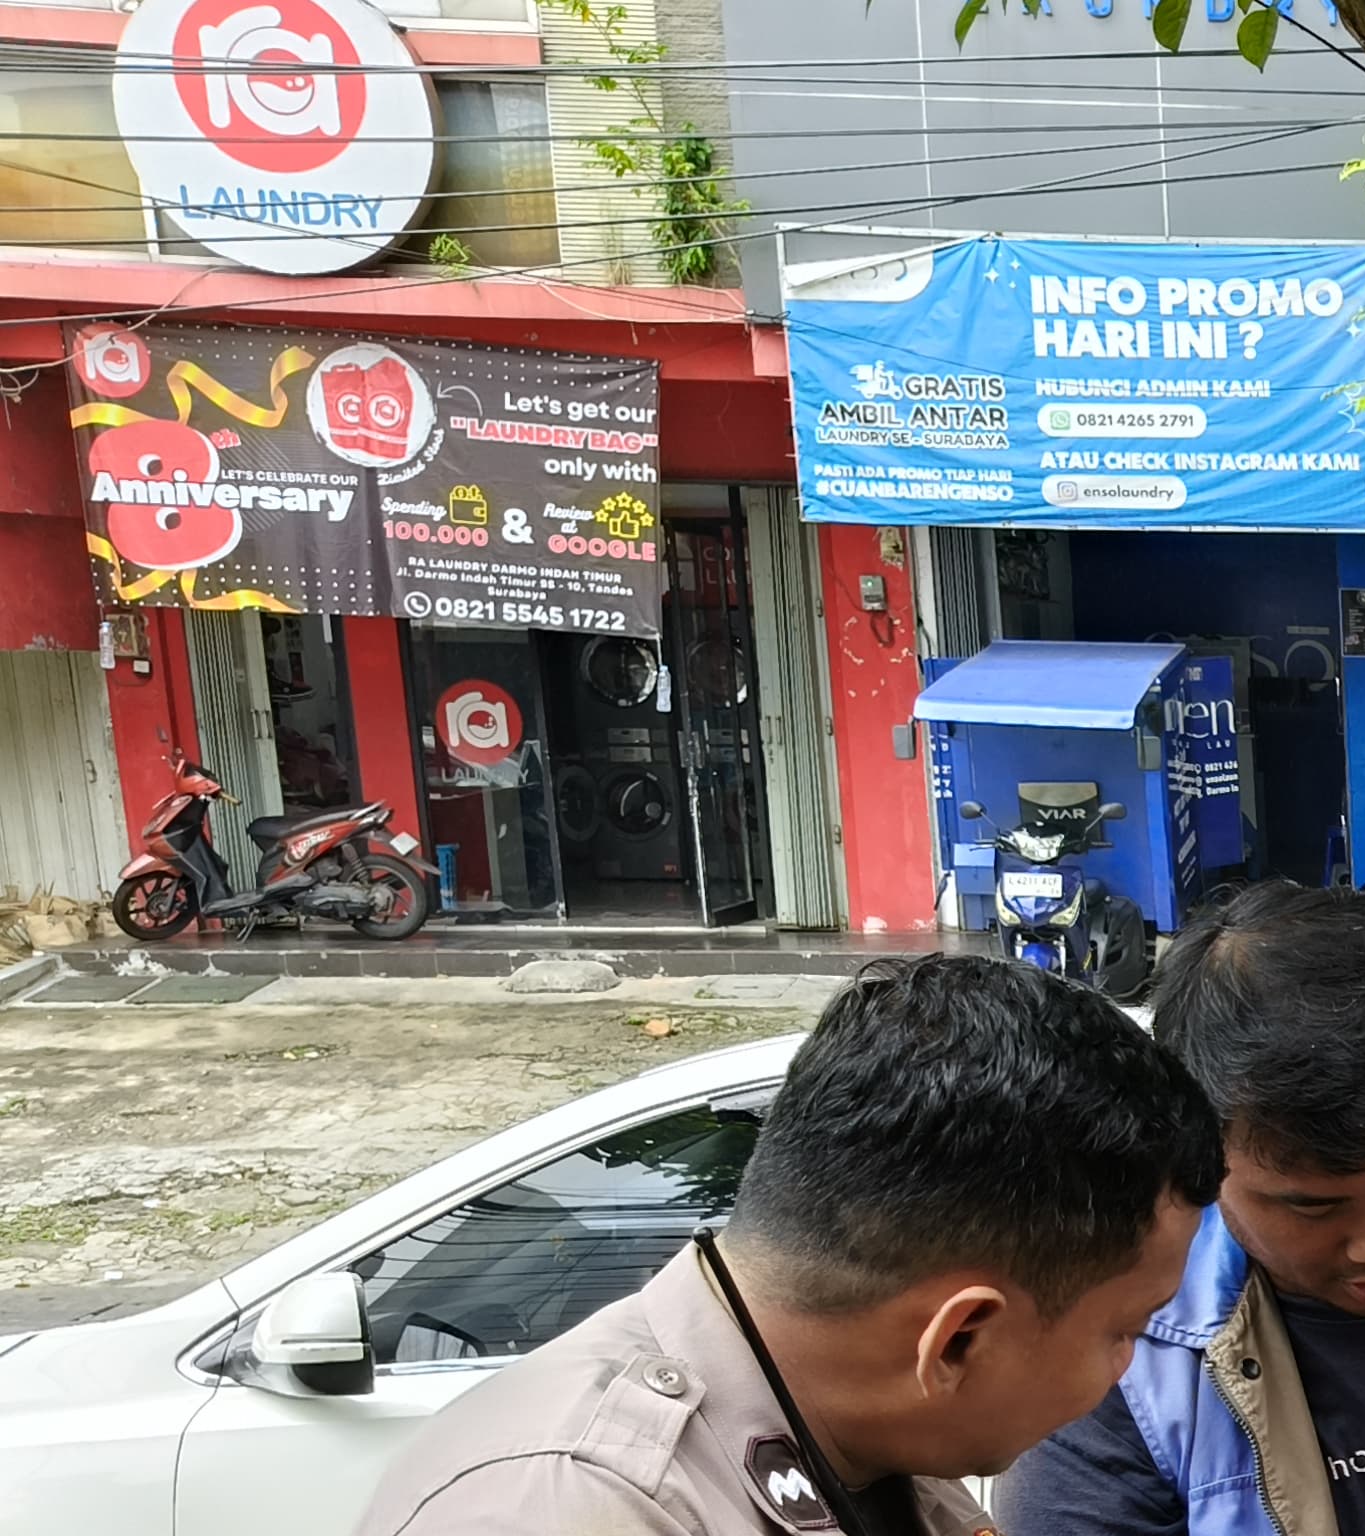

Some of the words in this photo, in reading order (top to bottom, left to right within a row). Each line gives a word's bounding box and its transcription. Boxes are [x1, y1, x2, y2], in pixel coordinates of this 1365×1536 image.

[180, 184, 383, 228] LAUNDRY
[1030, 275, 1147, 316] INFO
[1158, 277, 1343, 317] PROMO
[1033, 319, 1150, 358] HARI
[1163, 321, 1227, 359] INI
[1238, 321, 1264, 360] ?
[905, 377, 1003, 398] GRATIS
[1036, 378, 1131, 397] HUBUNGI
[1135, 379, 1208, 398] ADMIN
[1212, 380, 1271, 399] KAMI
[504, 391, 561, 415] Let's
[567, 401, 609, 422] get
[615, 405, 657, 423] our
[820, 403, 901, 424] AMBIL
[911, 407, 1005, 427] ANTAR
[1076, 413, 1113, 427] 0821
[1117, 414, 1155, 428] 4265
[1159, 414, 1194, 428] 2791
[818, 430, 889, 442] LAUNDRY
[924, 434, 1008, 446] SURABAYA
[544, 457, 597, 481] only
[602, 460, 657, 483] with
[1040, 451, 1099, 470] ATAU
[1103, 452, 1171, 471] CHECK
[1174, 453, 1298, 471] INSTAGRAM
[1302, 453, 1361, 471] KAMI
[221, 469, 254, 483] LET'S
[255, 470, 328, 484] CELEBRATE
[330, 474, 358, 486] OUR
[815, 464, 852, 477] PASTI
[857, 466, 886, 478] ADA
[888, 468, 942, 480] PROMO
[945, 470, 976, 481] TIAP
[978, 470, 1012, 482] HARI
[90, 470, 354, 521] Anniversary
[816, 480, 1013, 500] #CUANBARENGENSO
[1083, 485, 1174, 500] ensolaundry
[381, 497, 447, 521] Spending
[543, 503, 595, 521] Review
[383, 520, 489, 547] 100.000
[502, 508, 534, 544] &
[561, 520, 578, 534] at
[548, 535, 657, 562] GOOGLE
[408, 557, 426, 567] RA
[429, 559, 488, 573] LAUNDRY
[491, 565, 537, 577] DARMO
[540, 568, 580, 580] INDAH
[582, 571, 622, 583] TIMUR
[415, 569, 458, 581] Darmo
[461, 572, 497, 584] Indah
[500, 576, 537, 588] Timur
[487, 586, 547, 600] Surabaya
[435, 598, 495, 620] 0821
[502, 603, 564, 626] 5545
[569, 607, 625, 630] 1722
[1037, 808, 1086, 819] VIAR
